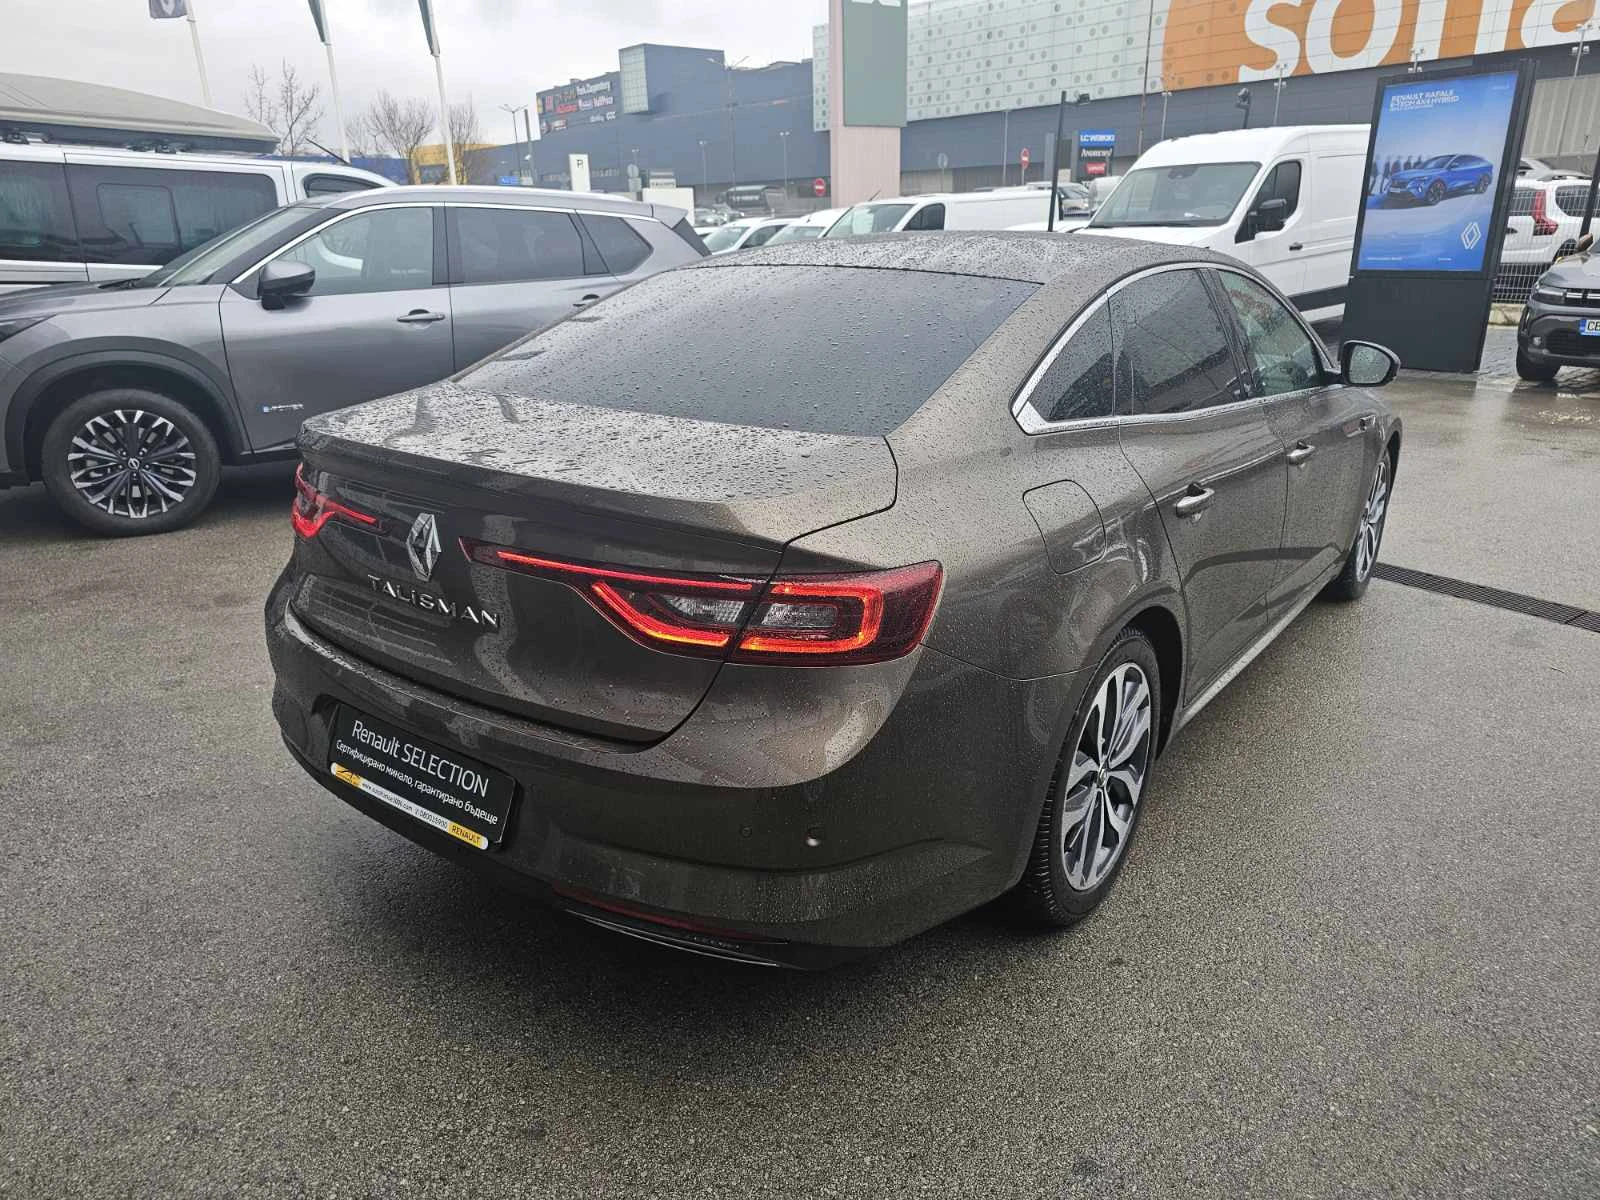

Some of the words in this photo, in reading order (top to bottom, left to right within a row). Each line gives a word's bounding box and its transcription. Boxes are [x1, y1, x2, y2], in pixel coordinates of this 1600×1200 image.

[367, 574, 499, 628] TALISMAN
[336, 739, 386, 773] Сертифицирано
[385, 765, 414, 788] минало,
[414, 780, 464, 809] гарантирано
[464, 800, 498, 825] бъдеще
[352, 720, 401, 759] Renault
[400, 743, 490, 798] SELECTION
[451, 824, 481, 845] RENAULT
